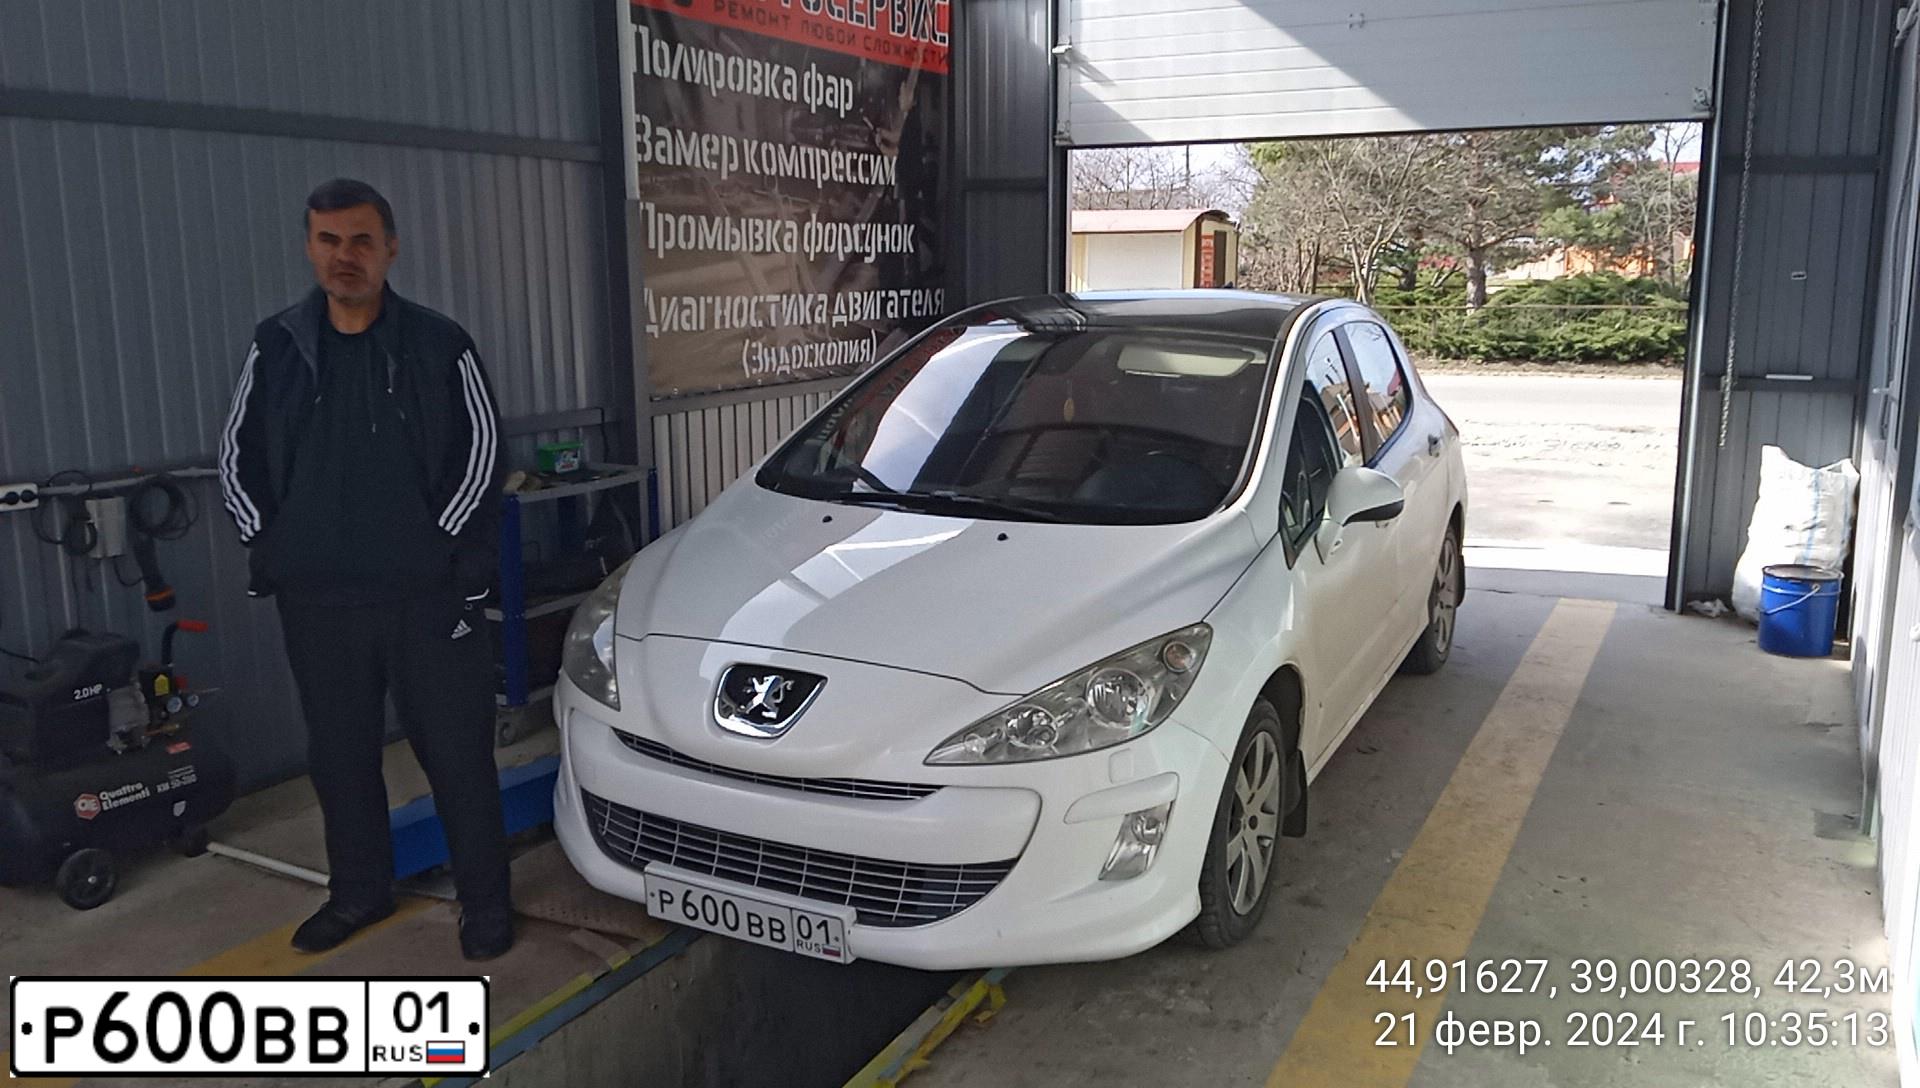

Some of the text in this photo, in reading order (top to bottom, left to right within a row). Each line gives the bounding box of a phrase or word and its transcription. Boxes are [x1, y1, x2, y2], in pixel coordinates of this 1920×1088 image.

[713, 0, 790, 31] РЕМОНТ
[631, 23, 854, 119] Полировка фар
[634, 114, 897, 189] Замер компрессии
[640, 201, 915, 264] Промывка форсунок
[644, 288, 945, 338] Диагностика двигателя
[743, 328, 877, 379] (Эндоскопия)
[99, 782, 143, 801] Quattro
[101, 787, 150, 811] Elementi
[657, 889, 830, 945] Р600ВВ 01
[796, 939, 821, 953] RUS
